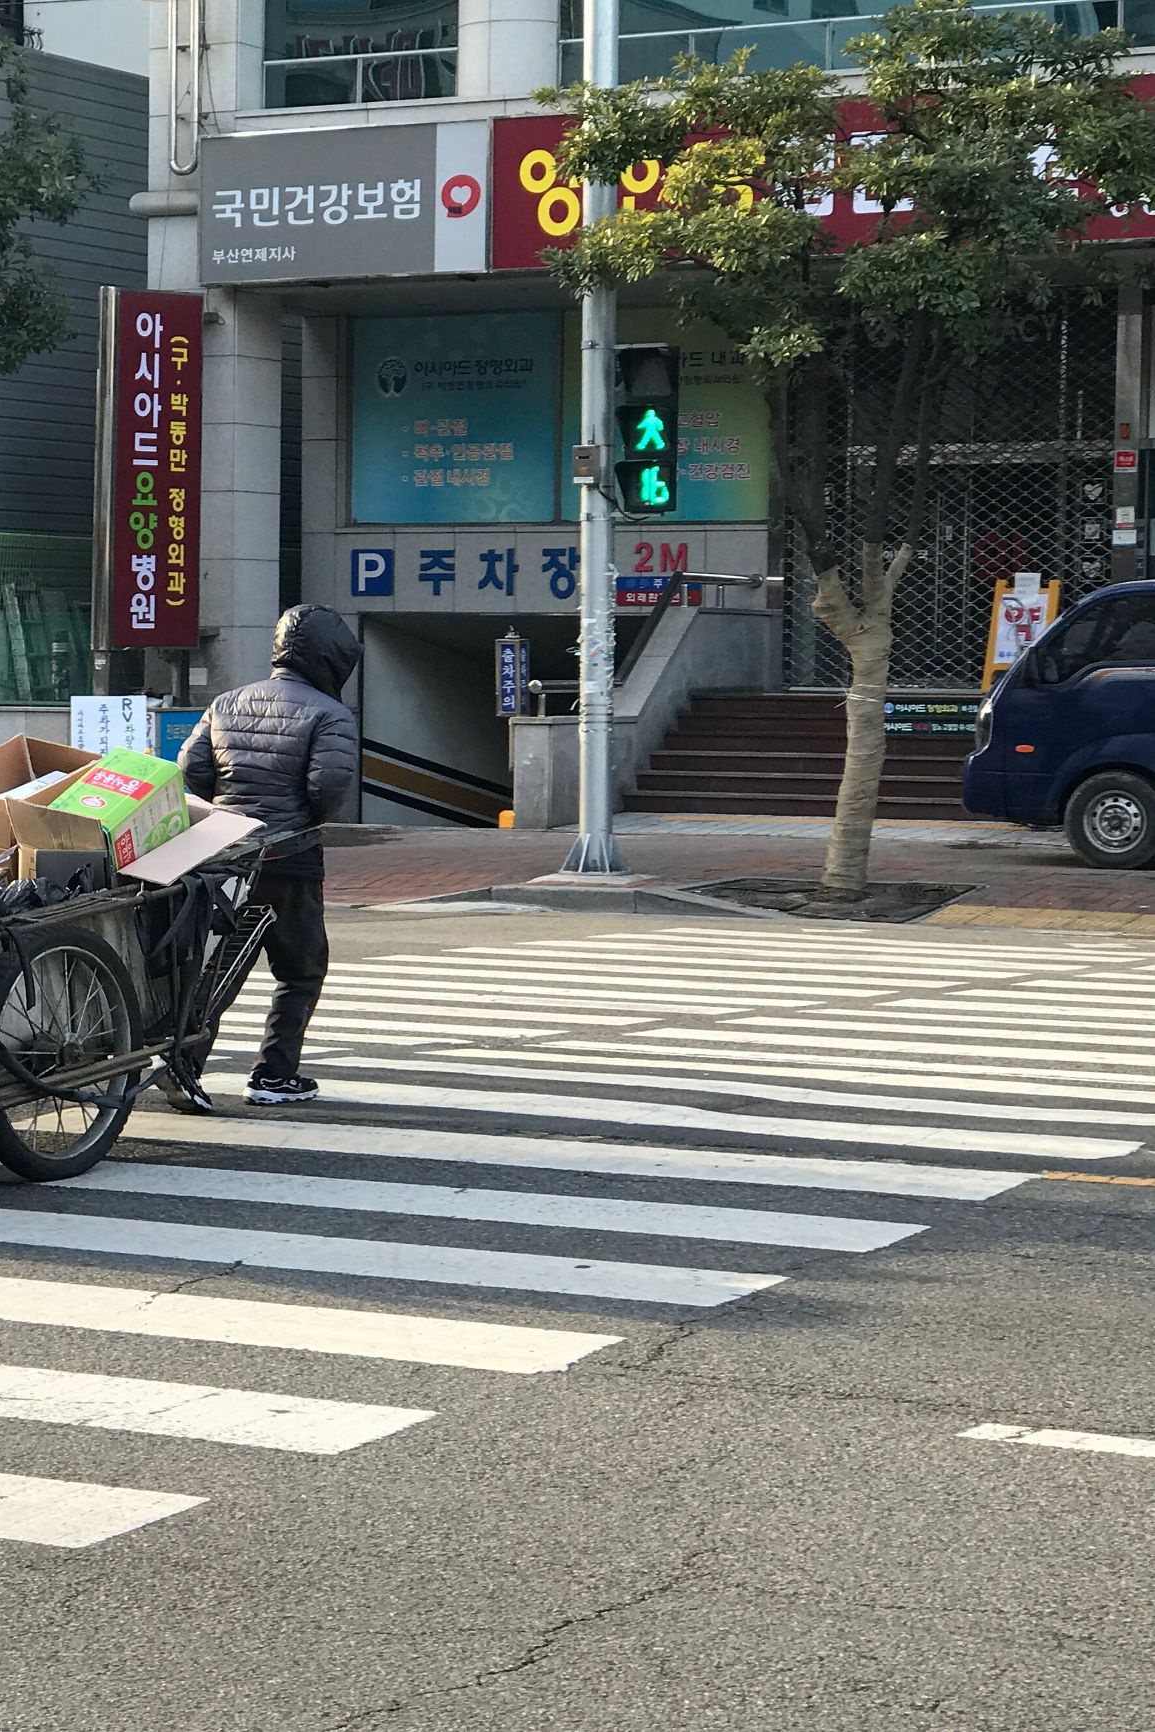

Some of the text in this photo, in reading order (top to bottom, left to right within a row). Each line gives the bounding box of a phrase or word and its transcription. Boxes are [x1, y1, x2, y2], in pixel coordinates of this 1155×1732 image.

[212, 179, 422, 228] 국민건강보험
[212, 245, 297, 265] 부산연제지사
[414, 357, 534, 377] 아시아드 정형외과
[694, 437, 741, 455] 내시경
[129, 311, 164, 631] 아시아드요양병원
[165, 487, 187, 607] 정형외과)
[358, 553, 386, 593] P
